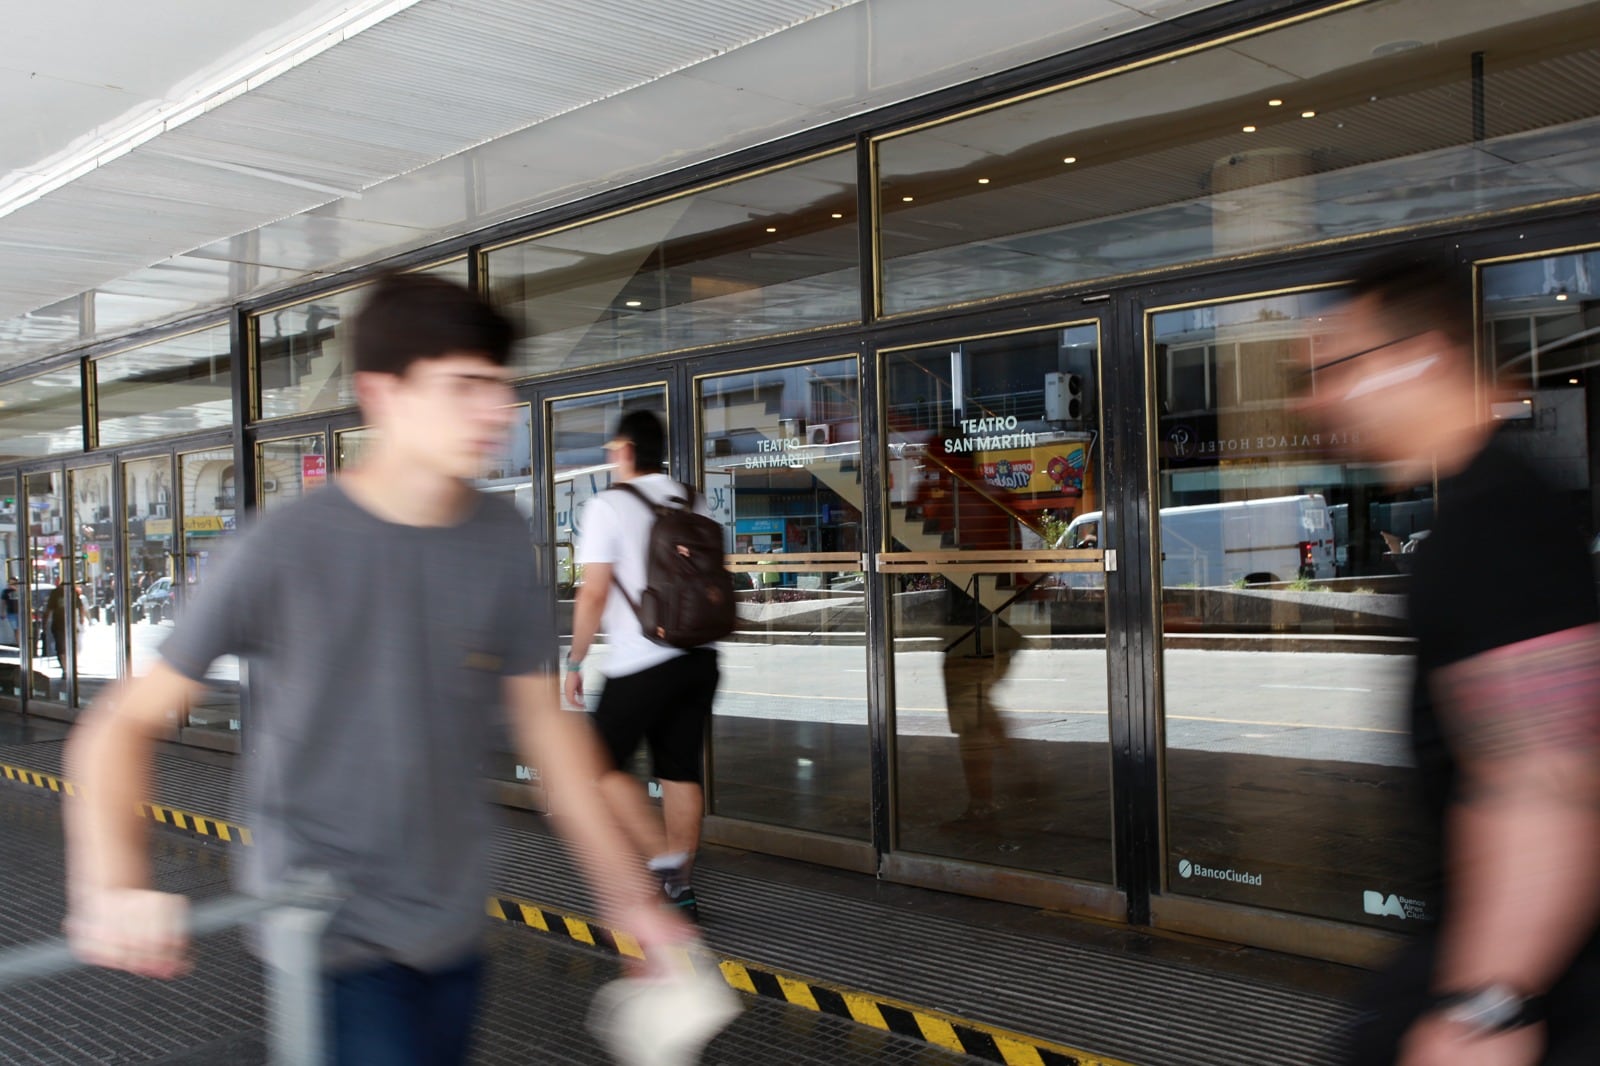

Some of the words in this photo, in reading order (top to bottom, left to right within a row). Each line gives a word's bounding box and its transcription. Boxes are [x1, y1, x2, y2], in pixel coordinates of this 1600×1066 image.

[960, 415, 1018, 434] TEATRO
[757, 437, 800, 453] TEATRO
[944, 437, 973, 454] SAN
[977, 429, 1036, 451] MARTÍN
[745, 455, 767, 469] SAN
[769, 450, 814, 468] MARTÍN
[1194, 863, 1262, 886] BancoCiudad
[1363, 889, 1407, 920] BA
